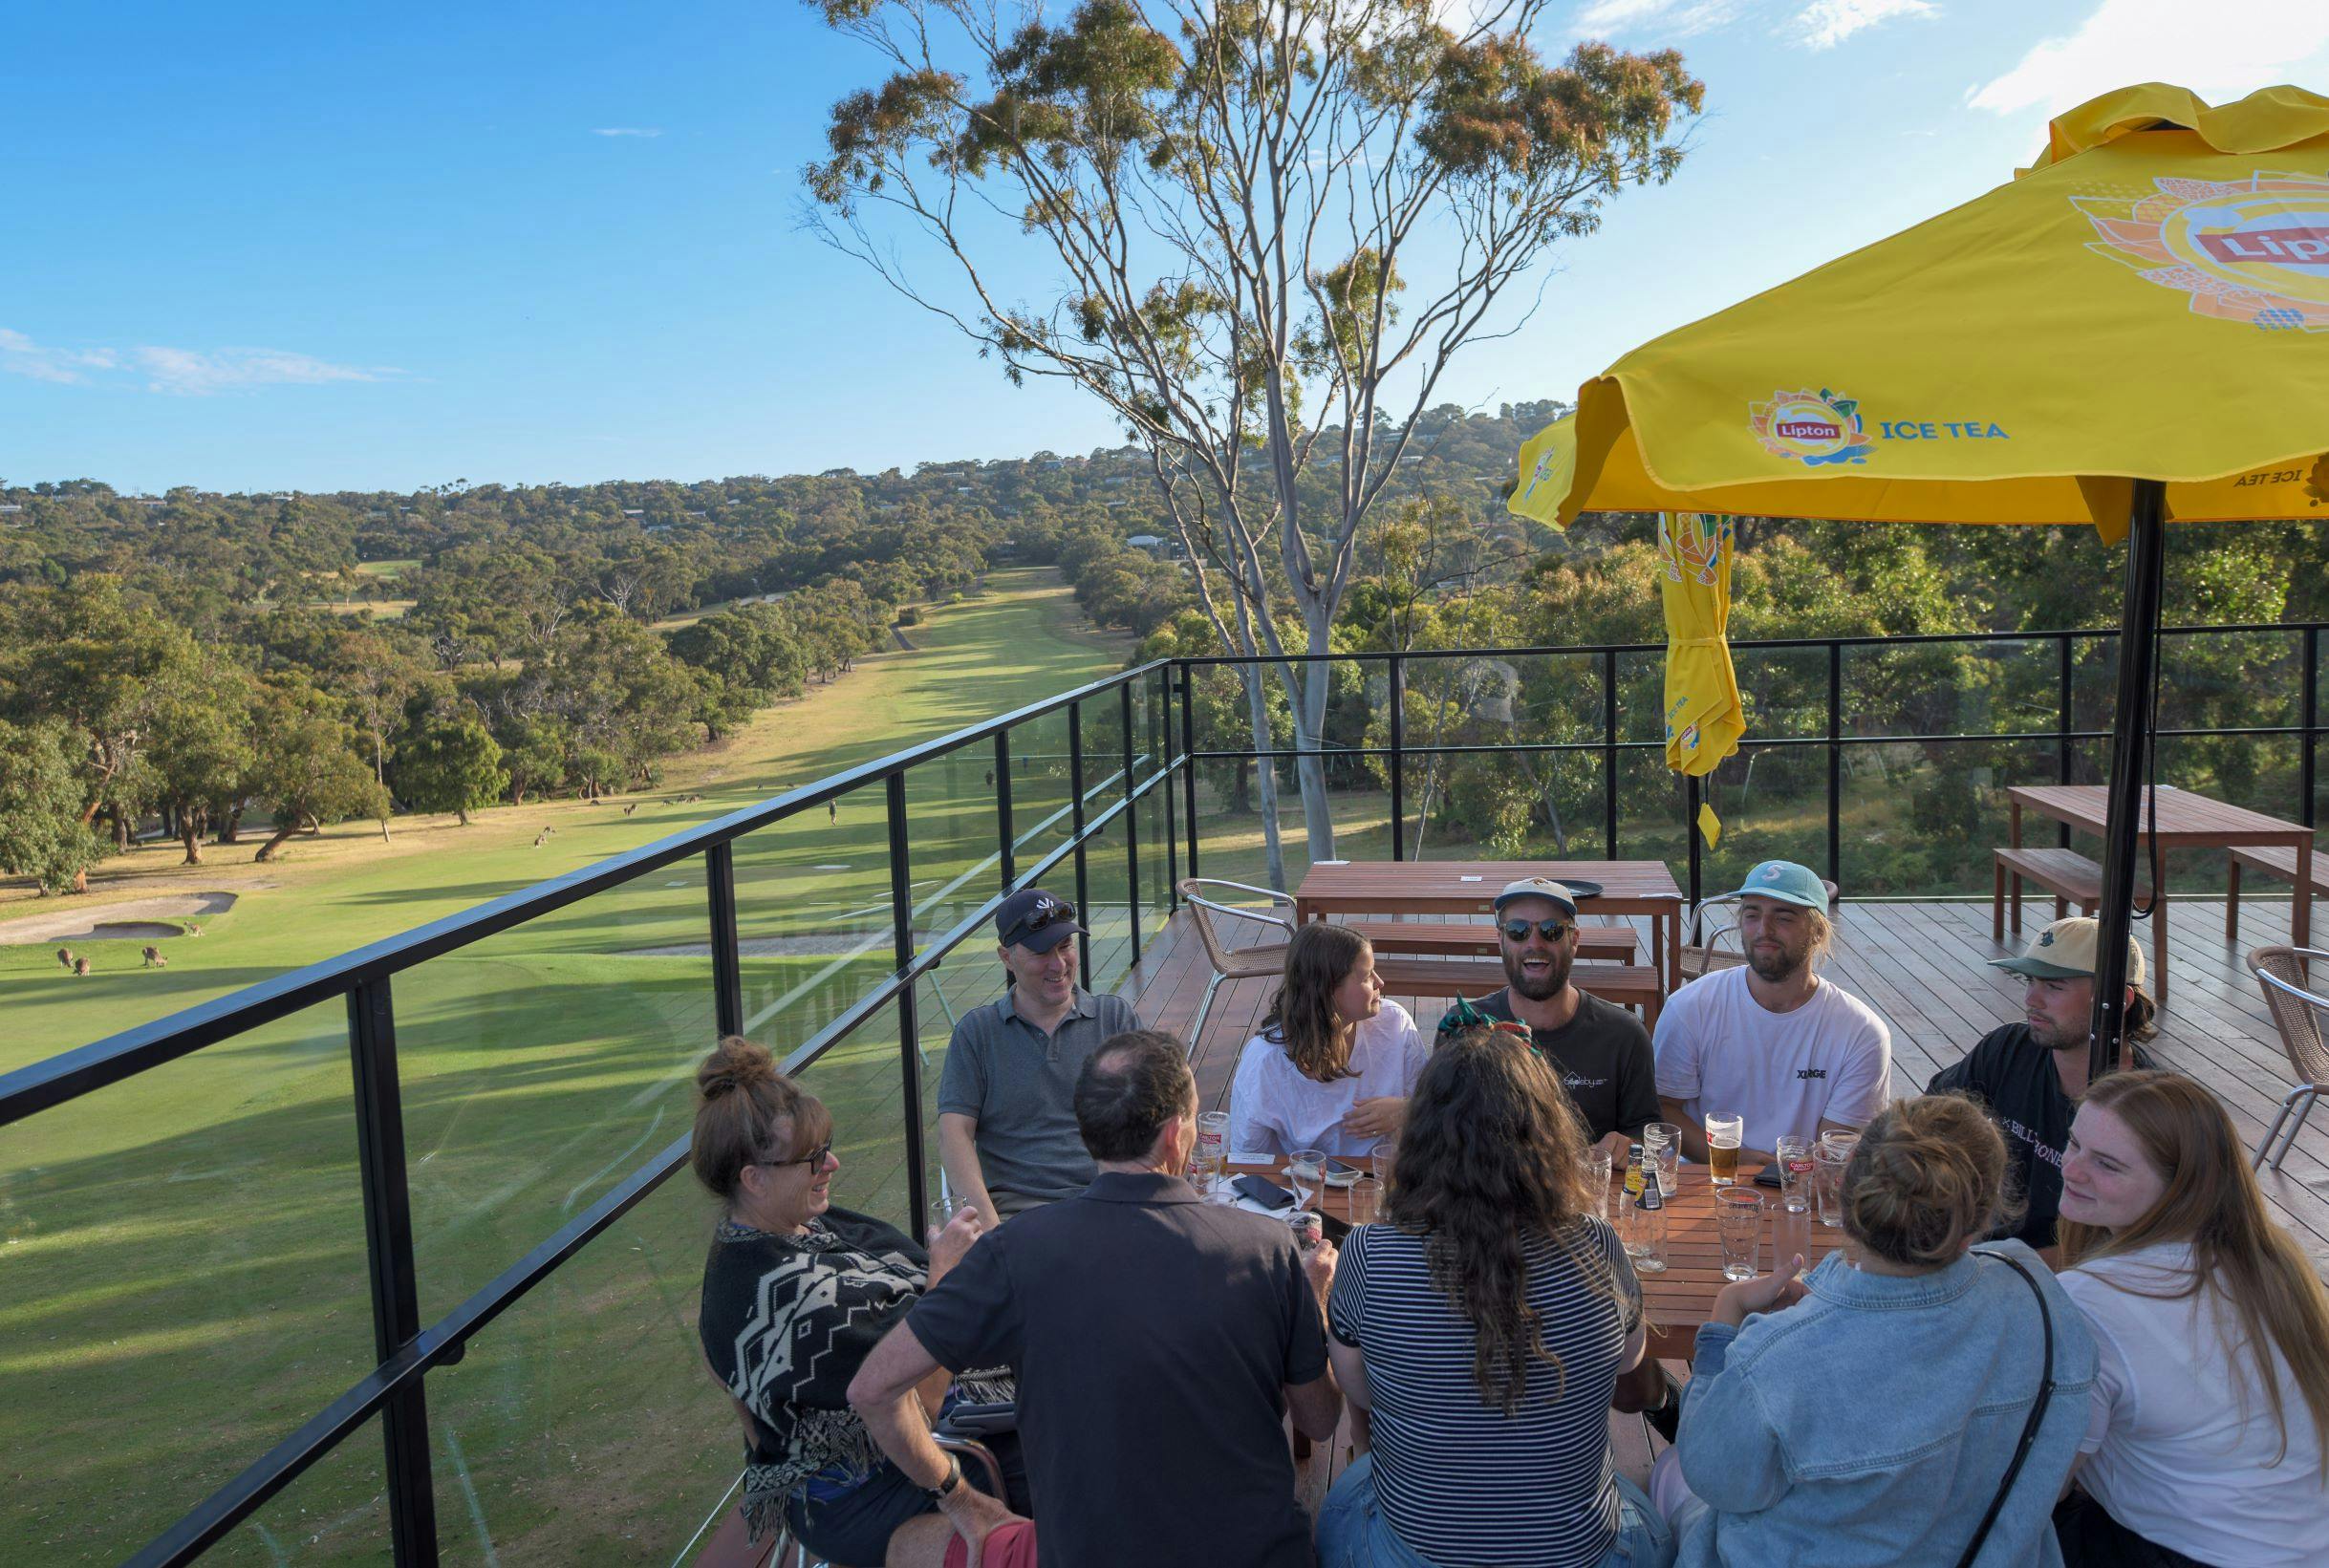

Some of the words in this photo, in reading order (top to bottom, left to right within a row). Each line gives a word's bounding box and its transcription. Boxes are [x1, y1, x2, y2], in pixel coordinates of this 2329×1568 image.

[2220, 235, 2329, 260] Lip
[1781, 425, 1835, 438] Lipton
[1880, 421, 1938, 440] ICE
[1943, 421, 2010, 440] TEA
